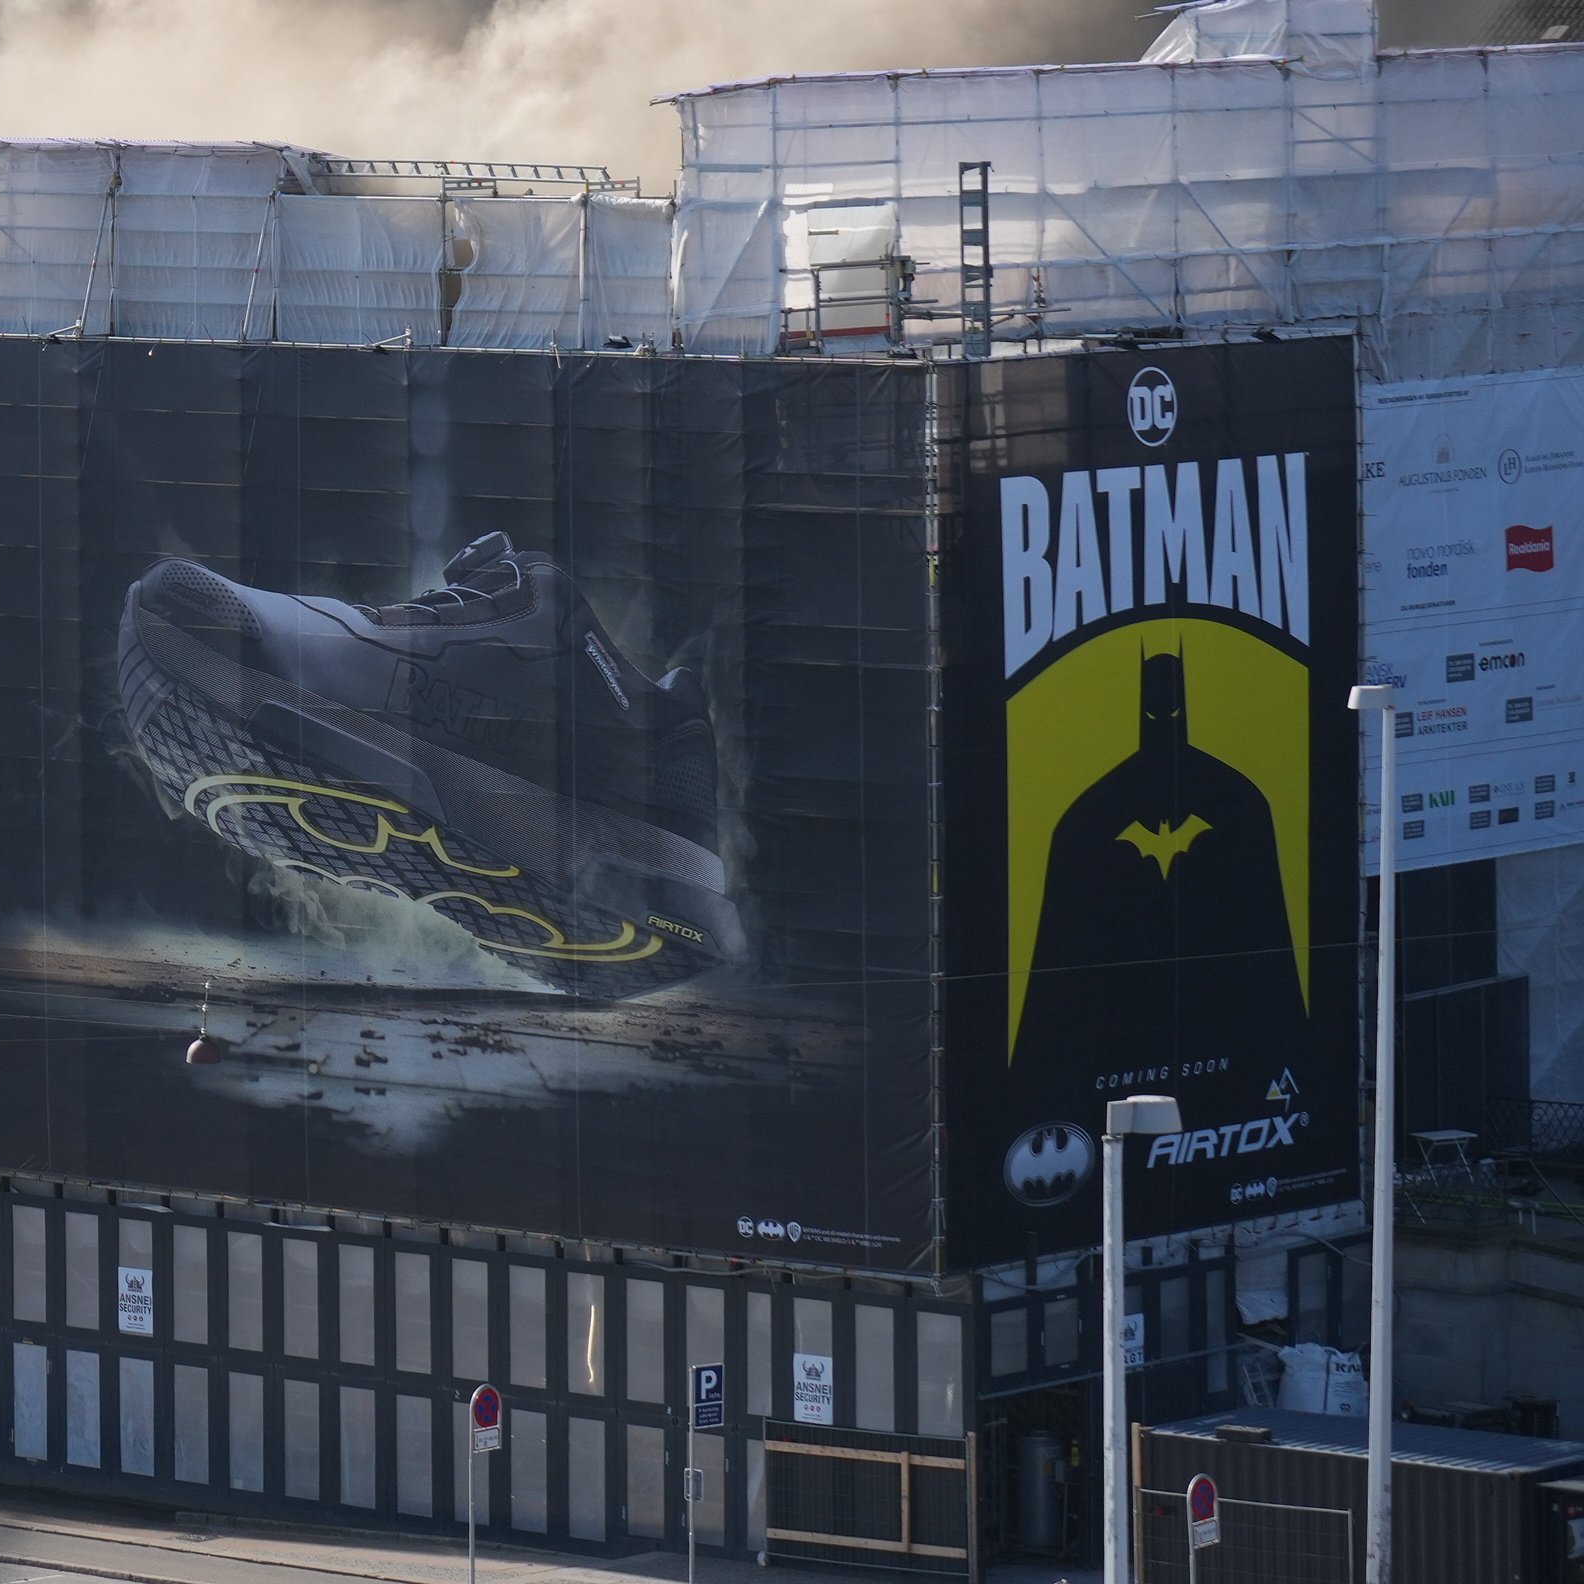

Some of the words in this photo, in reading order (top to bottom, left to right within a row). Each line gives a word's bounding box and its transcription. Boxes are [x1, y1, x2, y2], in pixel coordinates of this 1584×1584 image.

[1129, 384, 1174, 431] DC
[1406, 546, 1434, 561] novo
[1436, 539, 1476, 557] nordisk
[1508, 538, 1550, 555] Realdania
[1000, 451, 1310, 680] BATMAN
[1406, 561, 1448, 579] fonden
[1478, 651, 1525, 672] emcon
[1435, 706, 1469, 720] HANSEN
[1416, 720, 1469, 736] ARKITEKTER
[647, 915, 704, 944] AIRTOX
[1095, 1065, 1171, 1091] COMING
[1180, 1056, 1231, 1078] SOON
[738, 1220, 754, 1234] DC
[119, 1293, 152, 1306] ANSNEI
[119, 1303, 152, 1315] SECURITY
[700, 1369, 718, 1400] P
[796, 1381, 832, 1396] ANSNEI
[795, 1391, 832, 1406] SECURITY
